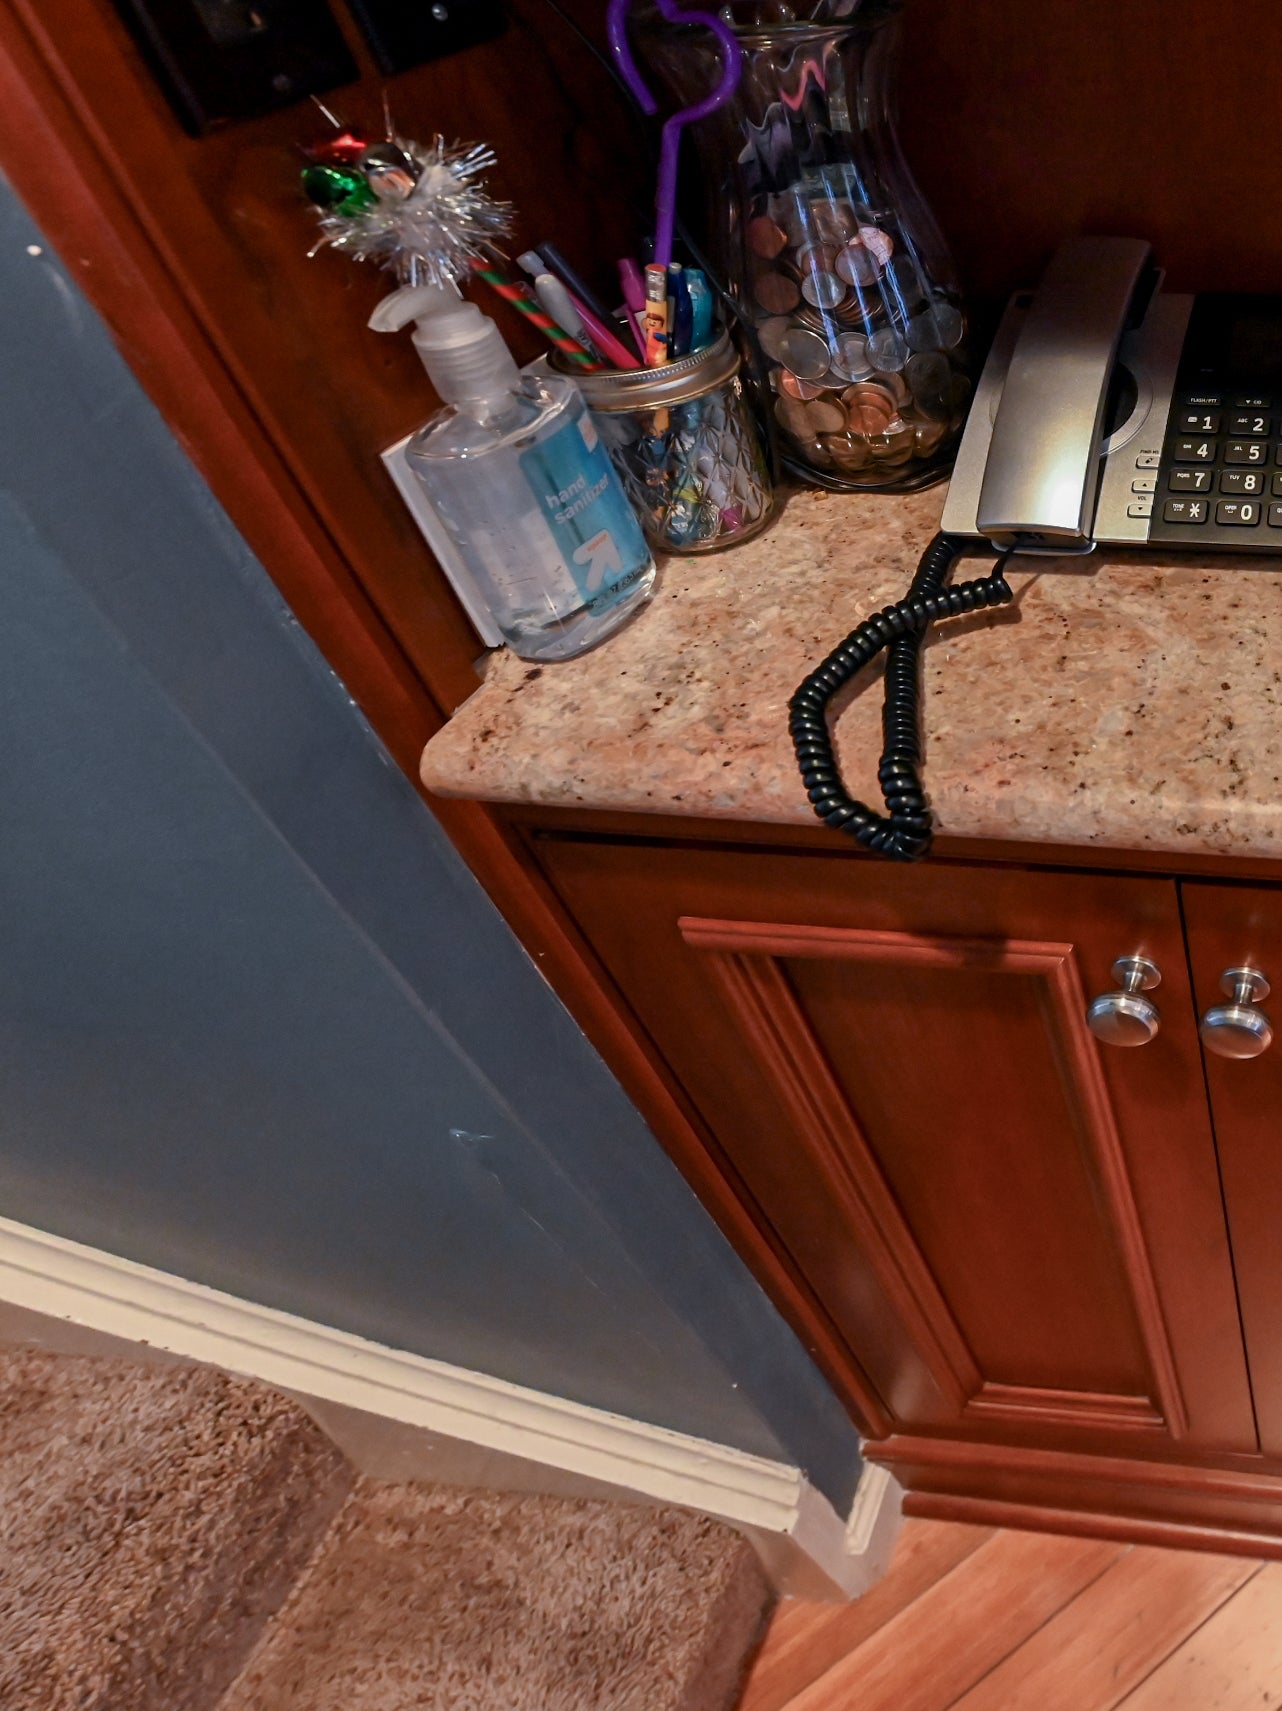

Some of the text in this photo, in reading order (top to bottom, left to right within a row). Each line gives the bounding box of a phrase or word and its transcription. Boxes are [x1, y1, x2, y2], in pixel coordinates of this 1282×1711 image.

[1202, 416, 1213, 430] 1
[1252, 417, 1264, 432] 2
[1196, 443, 1208, 458] 4
[1248, 445, 1260, 460] 5
[1194, 472, 1205, 488] 7
[1244, 474, 1256, 490] 8
[545, 473, 586, 509] hand
[554, 473, 609, 524] sanitizer
[1240, 504, 1252, 521] 0
